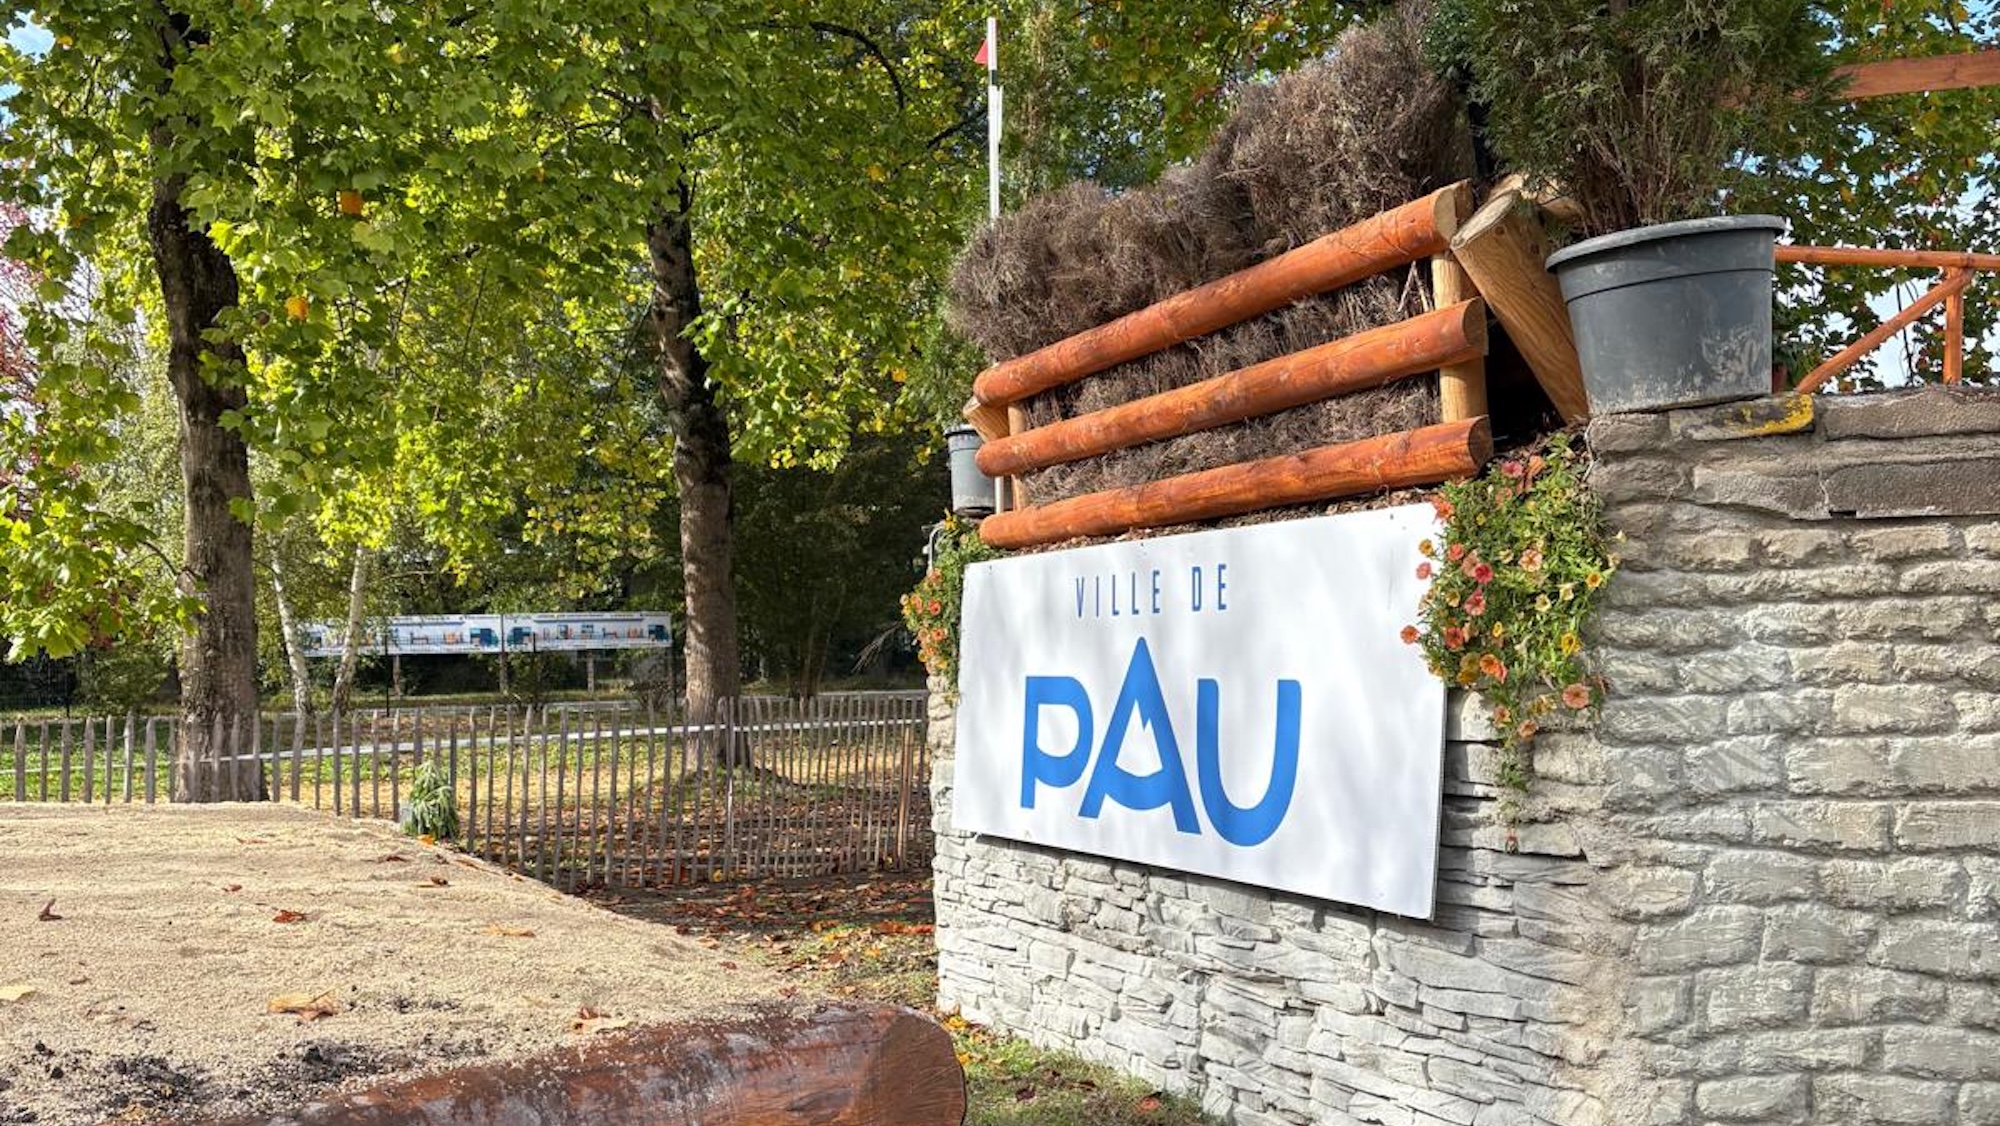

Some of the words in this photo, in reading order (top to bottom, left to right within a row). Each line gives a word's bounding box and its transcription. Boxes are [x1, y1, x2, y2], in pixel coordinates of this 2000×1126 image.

[1076, 569, 1160, 618] VILLE
[1191, 564, 1227, 611] DE
[1020, 636, 1302, 847] PAU
